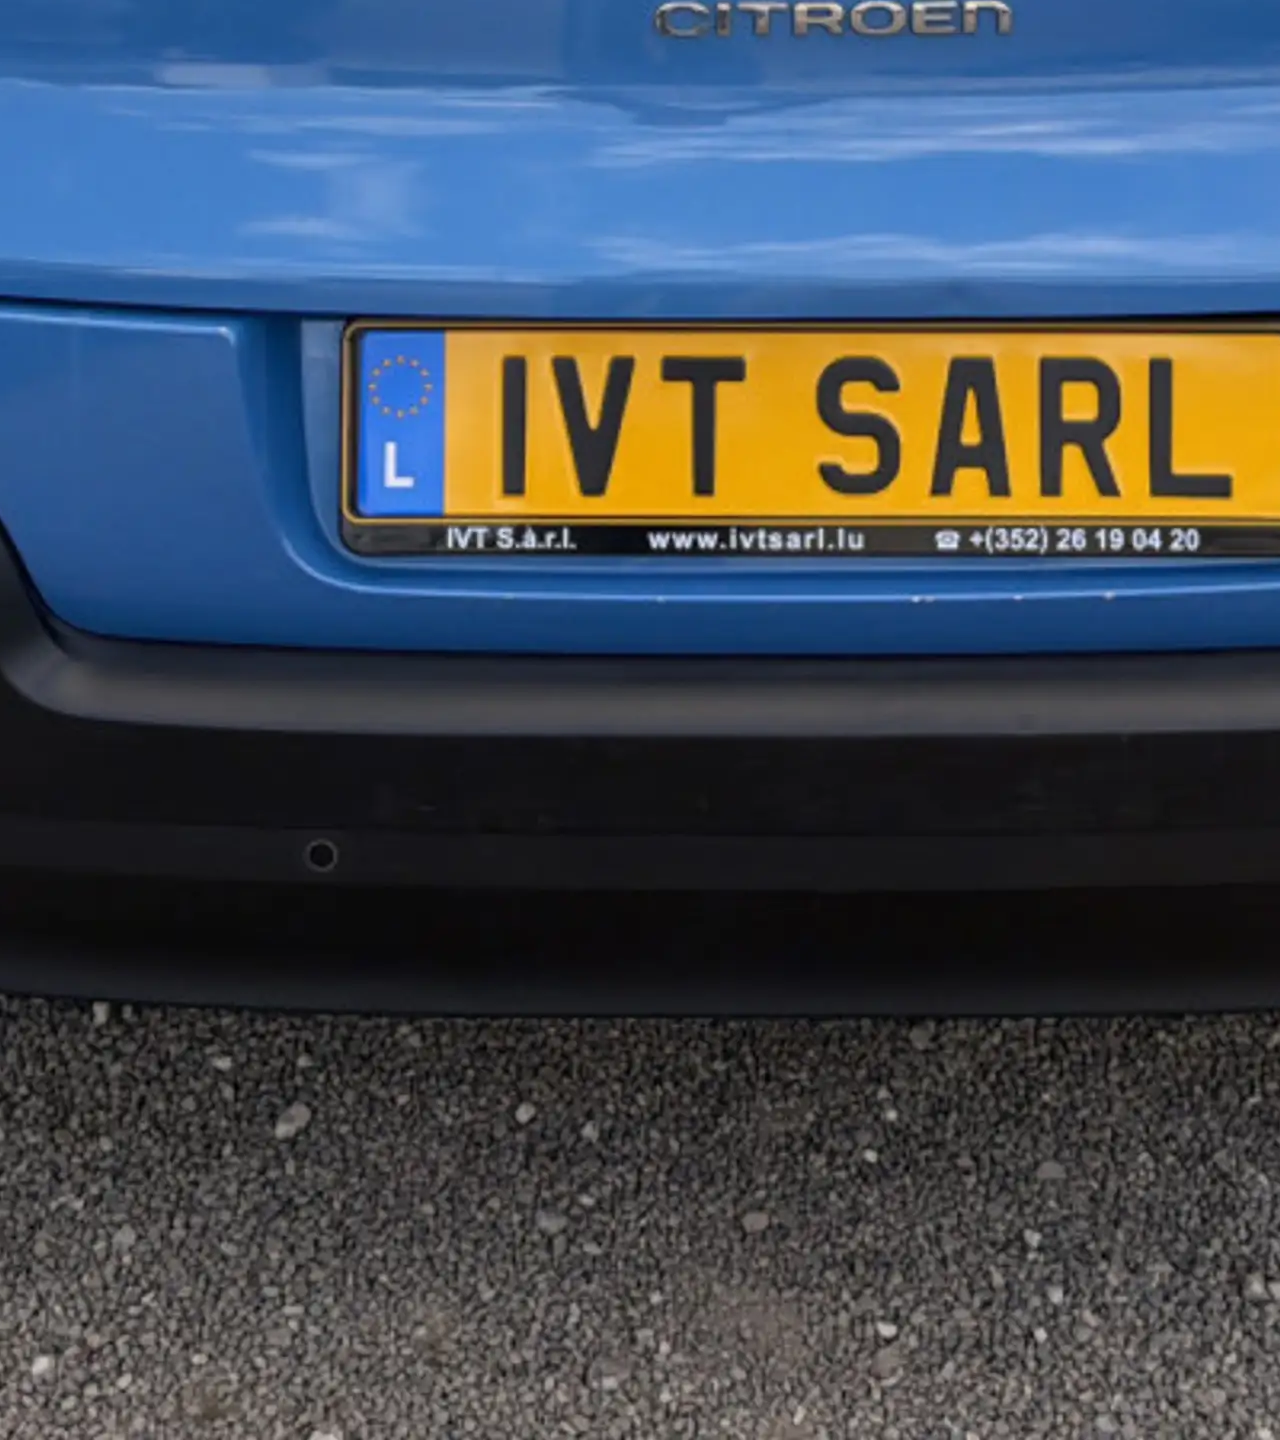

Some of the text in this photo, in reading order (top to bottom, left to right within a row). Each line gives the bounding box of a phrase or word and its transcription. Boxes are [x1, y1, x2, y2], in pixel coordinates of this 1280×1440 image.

[501, 355, 1234, 498] IVT SARL
[384, 441, 415, 488] L
[446, 527, 489, 550] IVT
[646, 527, 866, 550] www.ivtsarl.lu
[968, 526, 1201, 554] +(352) 26 19 04 20
